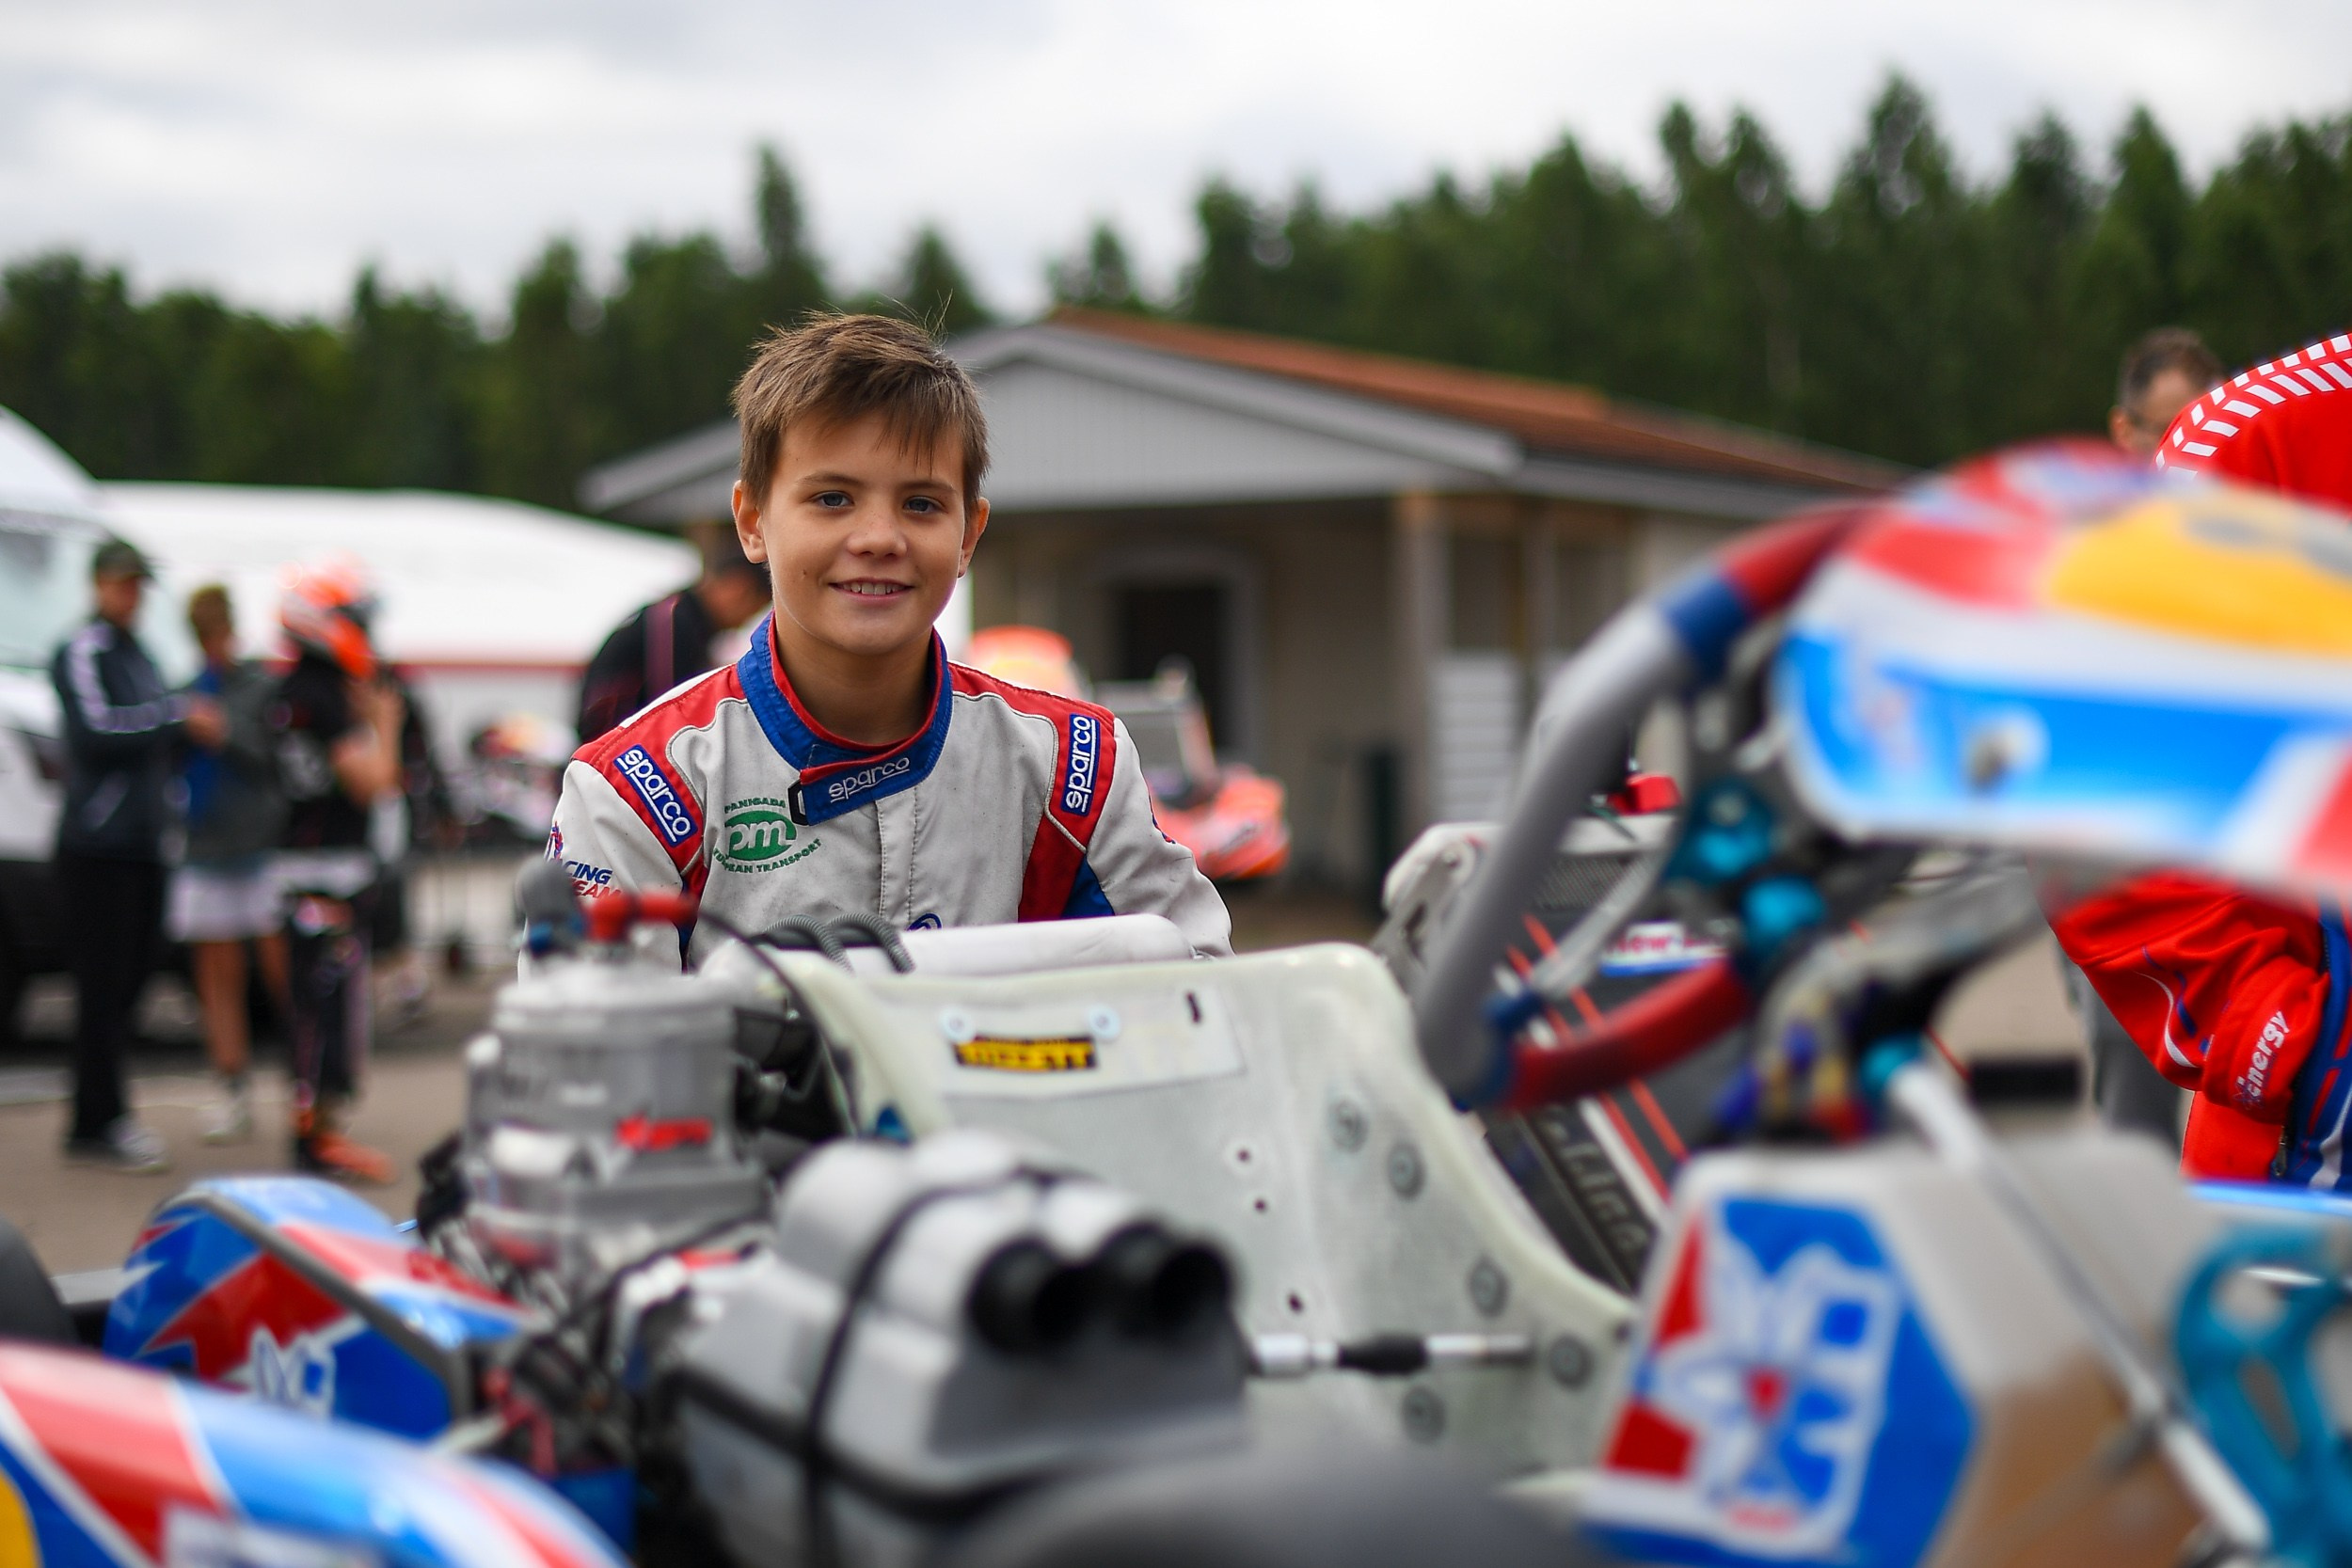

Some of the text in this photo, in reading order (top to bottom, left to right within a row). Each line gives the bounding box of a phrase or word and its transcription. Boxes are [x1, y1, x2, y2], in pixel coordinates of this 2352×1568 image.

[829, 757, 910, 800] sparco
[1066, 716, 1093, 810] sparco
[622, 750, 691, 837] sparco
[724, 797, 787, 814] PANIGADA
[563, 860, 613, 885] CING
[756, 837, 822, 873] TRANSPORT
[571, 878, 622, 899] EAM
